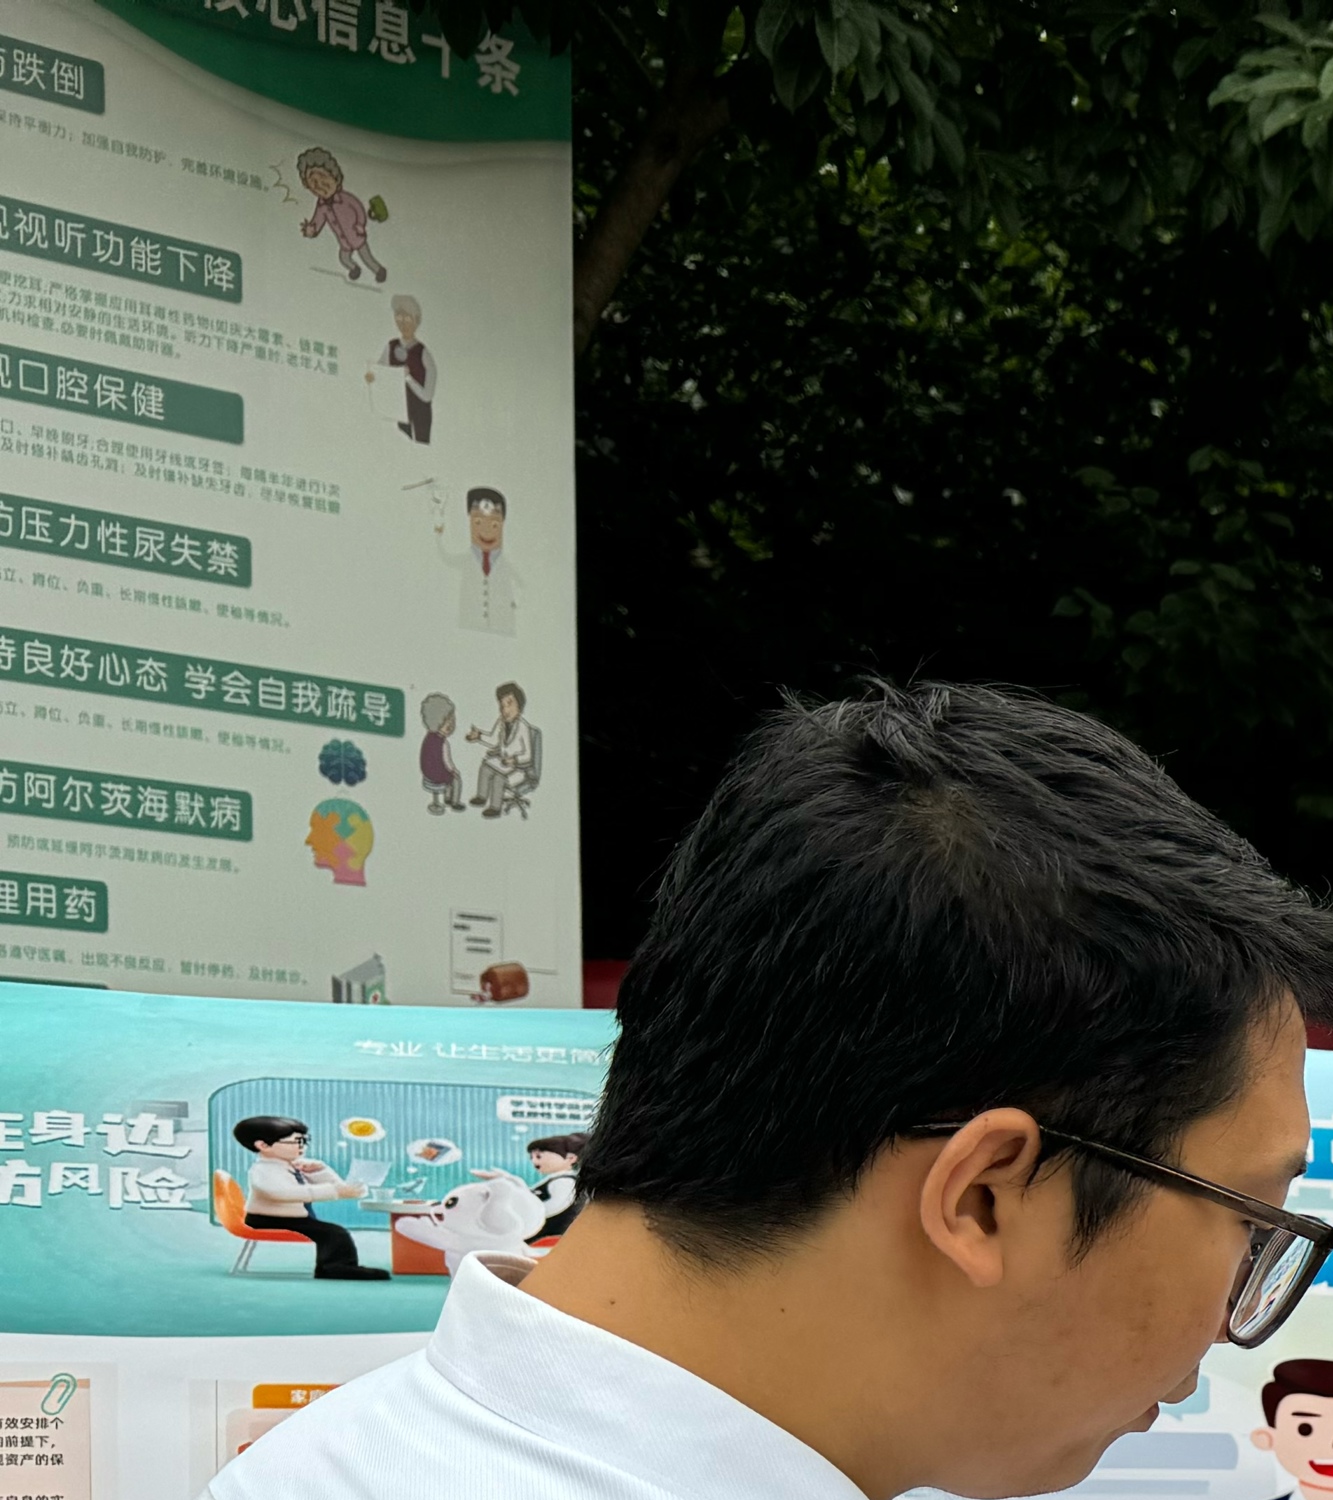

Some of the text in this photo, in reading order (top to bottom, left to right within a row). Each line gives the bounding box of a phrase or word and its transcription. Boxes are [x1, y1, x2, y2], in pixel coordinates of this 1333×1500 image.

[0, 47, 84, 99] 跌倒
[0, 204, 236, 293] 视听功能下降
[184, 664, 392, 727] 学会自我疏导
[434, 1042, 612, 1067] 让生活更简
[0, 1417, 65, 1431] 效安排个
[0, 1435, 56, 1450] 前提下,
